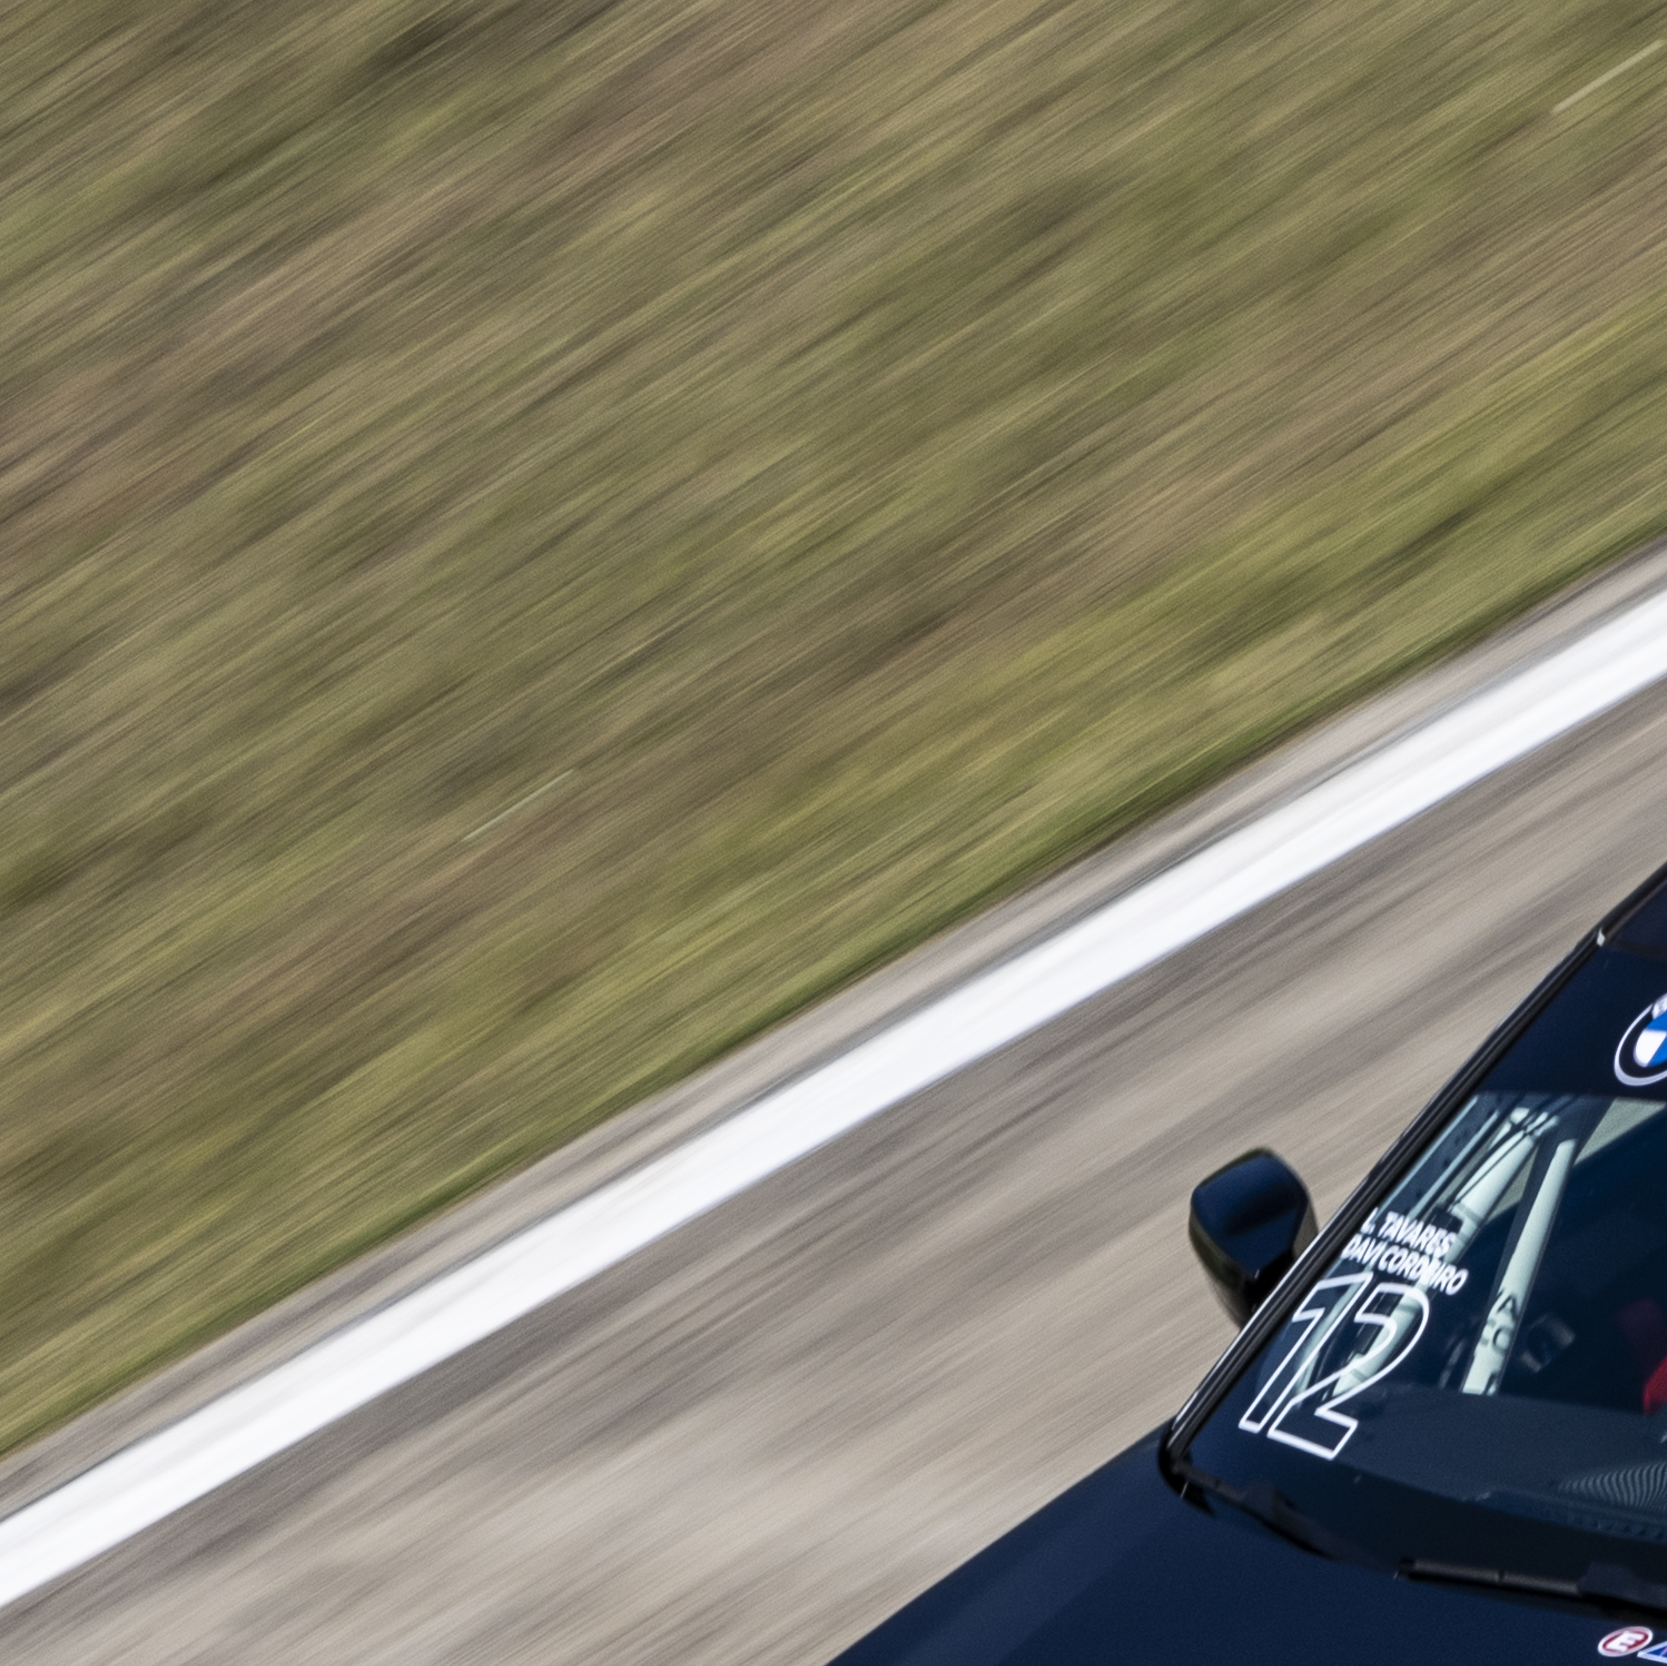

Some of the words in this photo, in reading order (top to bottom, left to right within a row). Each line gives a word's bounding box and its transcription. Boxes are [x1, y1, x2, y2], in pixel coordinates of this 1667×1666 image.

[1340, 1233, 1388, 1265] DAVI
[1377, 1211, 1457, 1259] TAVARES
[1238, 1272, 1430, 1460] 12
